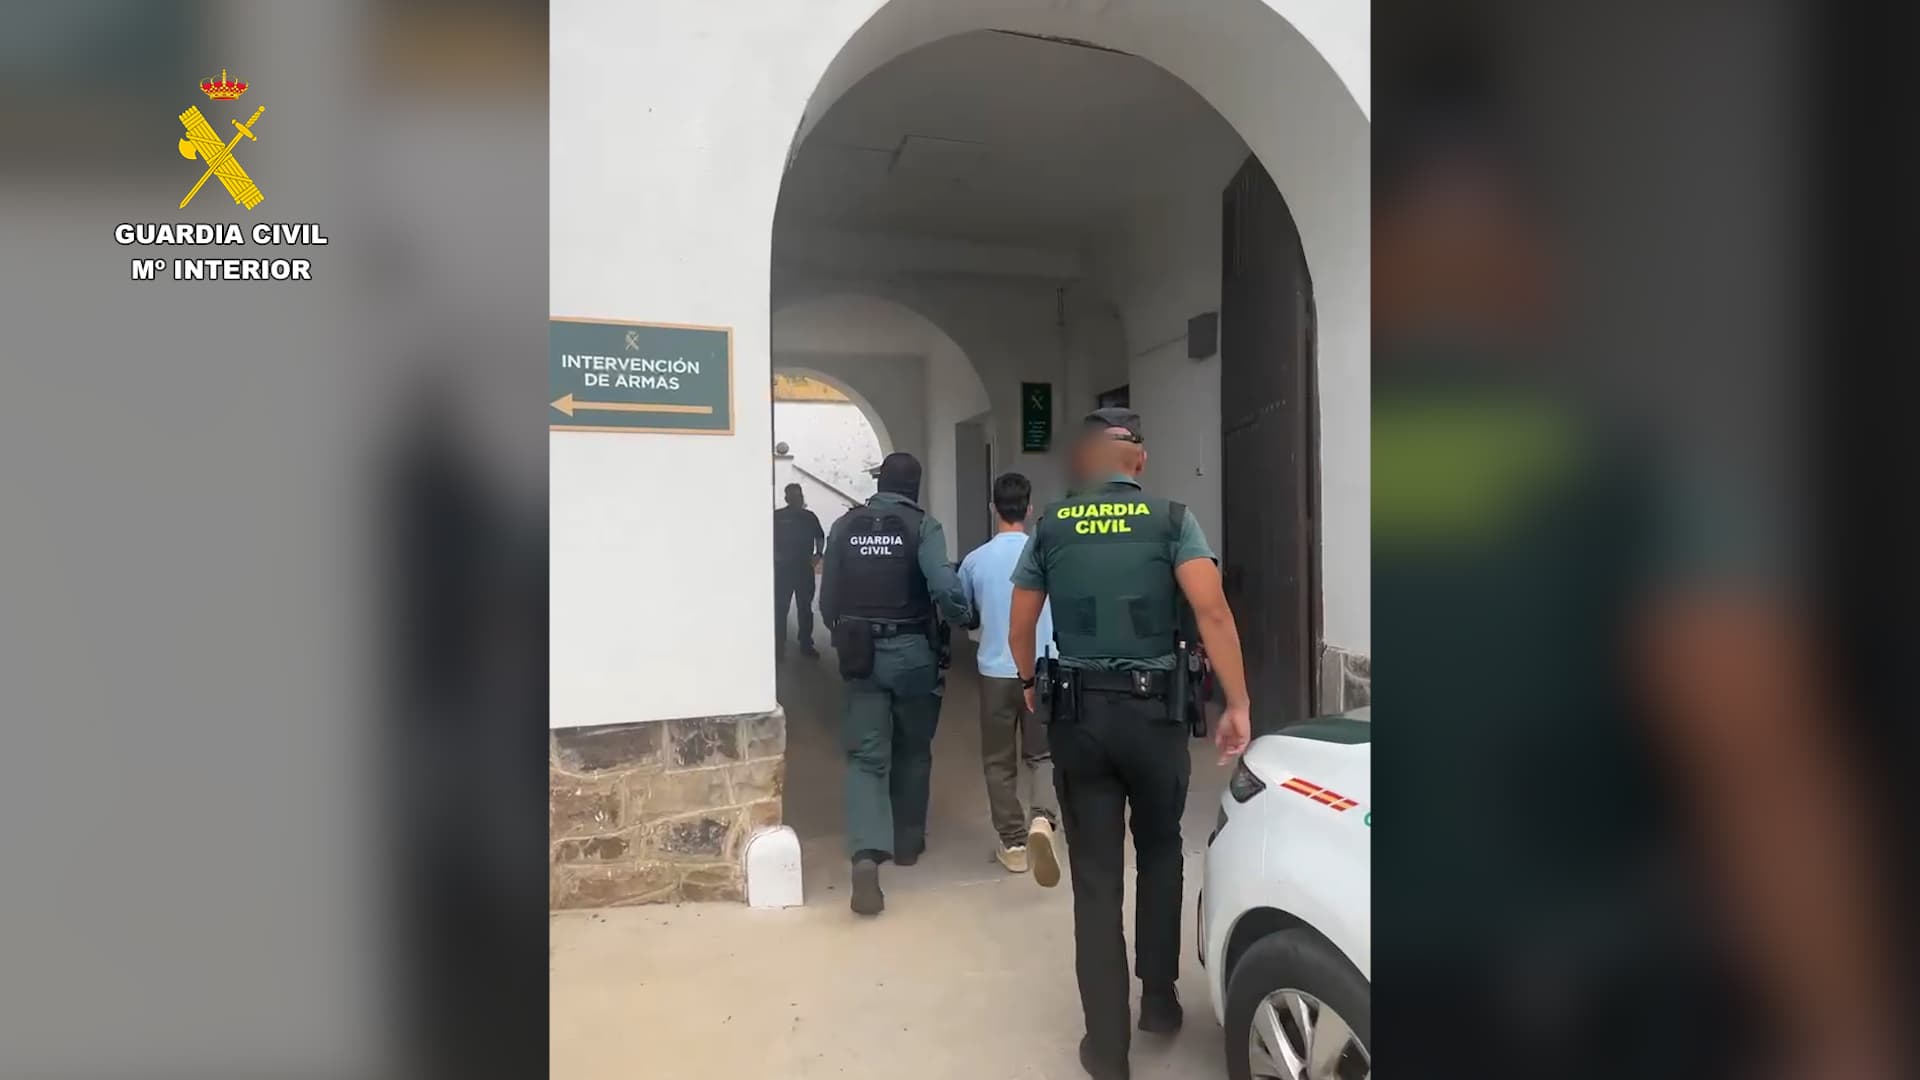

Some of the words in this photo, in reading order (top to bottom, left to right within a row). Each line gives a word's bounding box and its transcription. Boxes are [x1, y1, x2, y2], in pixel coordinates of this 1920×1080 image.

[561, 354, 700, 374] INTERVENCIÓN
[585, 373, 610, 387] DE
[615, 374, 680, 390] ARMAS
[1057, 503, 1150, 519] GUARDIA
[1075, 519, 1131, 534] CIVIL
[850, 535, 903, 545] GUARDIA
[860, 546, 892, 555] CIVIL
